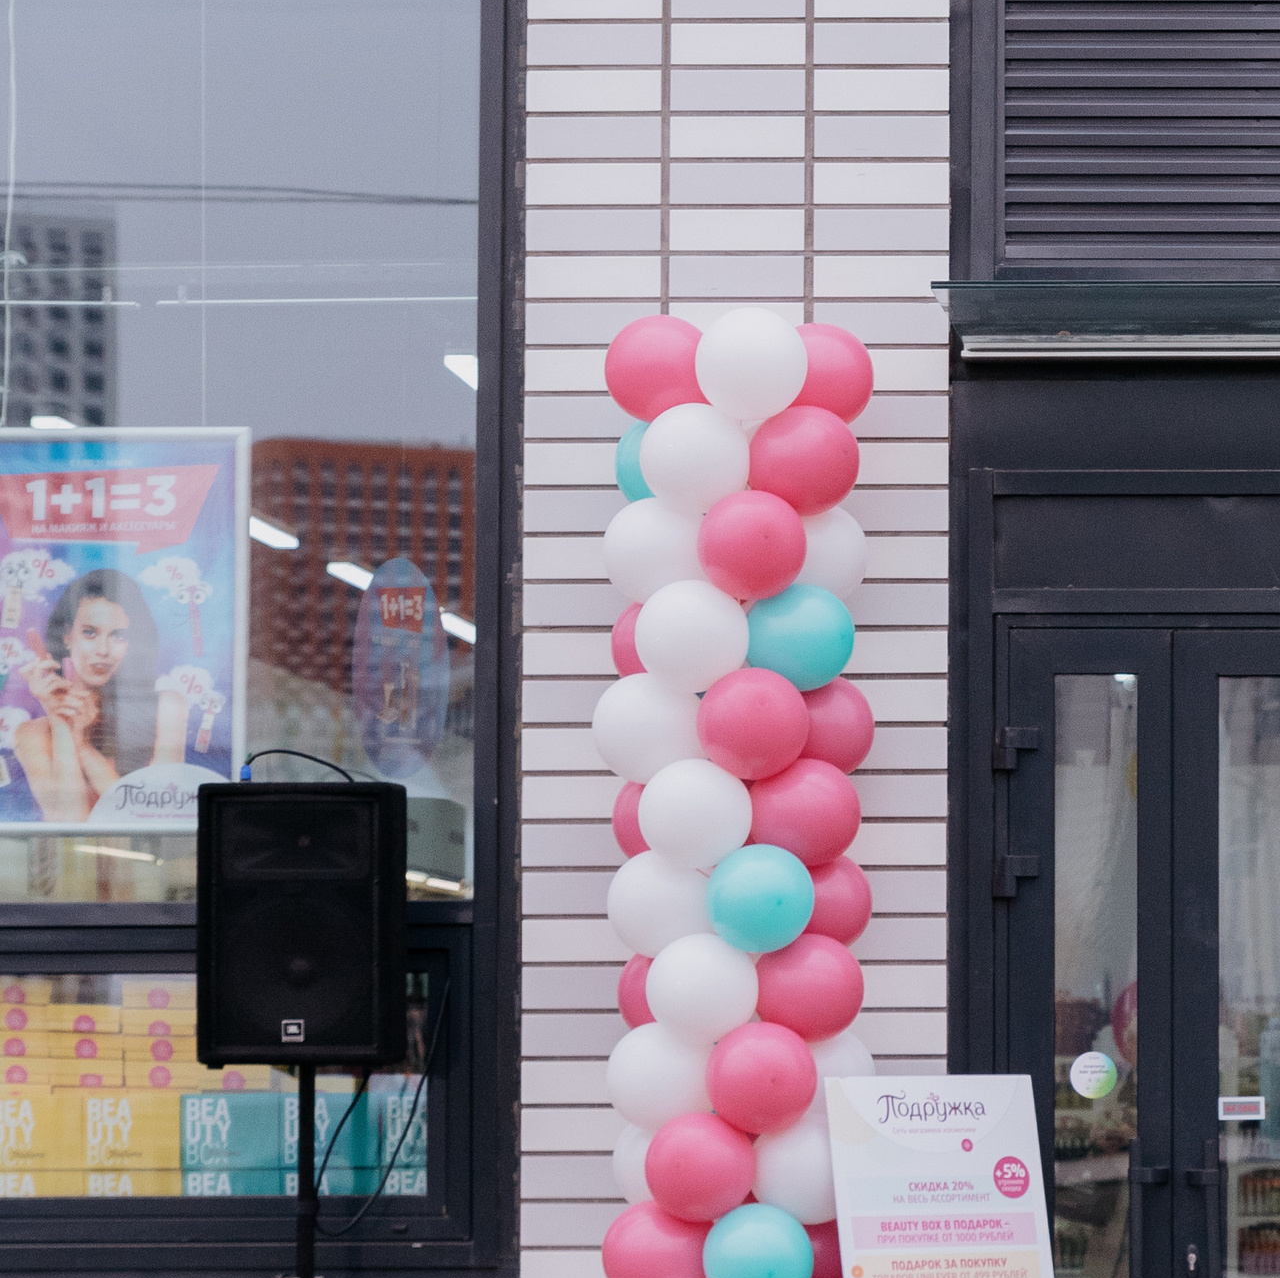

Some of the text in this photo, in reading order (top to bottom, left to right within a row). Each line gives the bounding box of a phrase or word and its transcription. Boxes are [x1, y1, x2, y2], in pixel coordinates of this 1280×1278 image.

[26, 475, 177, 521] 1+1=3
[381, 594, 422, 620] 1+1=3
[115, 780, 198, 810] Подруж
[0, 1099, 34, 1124] EA
[285, 1097, 329, 1120] BA
[877, 1090, 986, 1124] Подружка
[285, 1119, 330, 1142] UY
[909, 1181, 974, 1192] СКИДКА 20%
[893, 1193, 990, 1204] НА ВЕСЬ АССОРТИМЕНТ
[877, 1229, 1014, 1244] ПРИ ПОКУПКЕ ОТ 1000 РУБЛЕЙ
[881, 1221, 918, 1232] BEAUTY
[922, 1221, 941, 1231] BOX
[954, 1219, 1002, 1230] ПОДАРОК
[892, 1257, 1007, 1271] ПОДАРОК ЗА ПОКУПКУ
